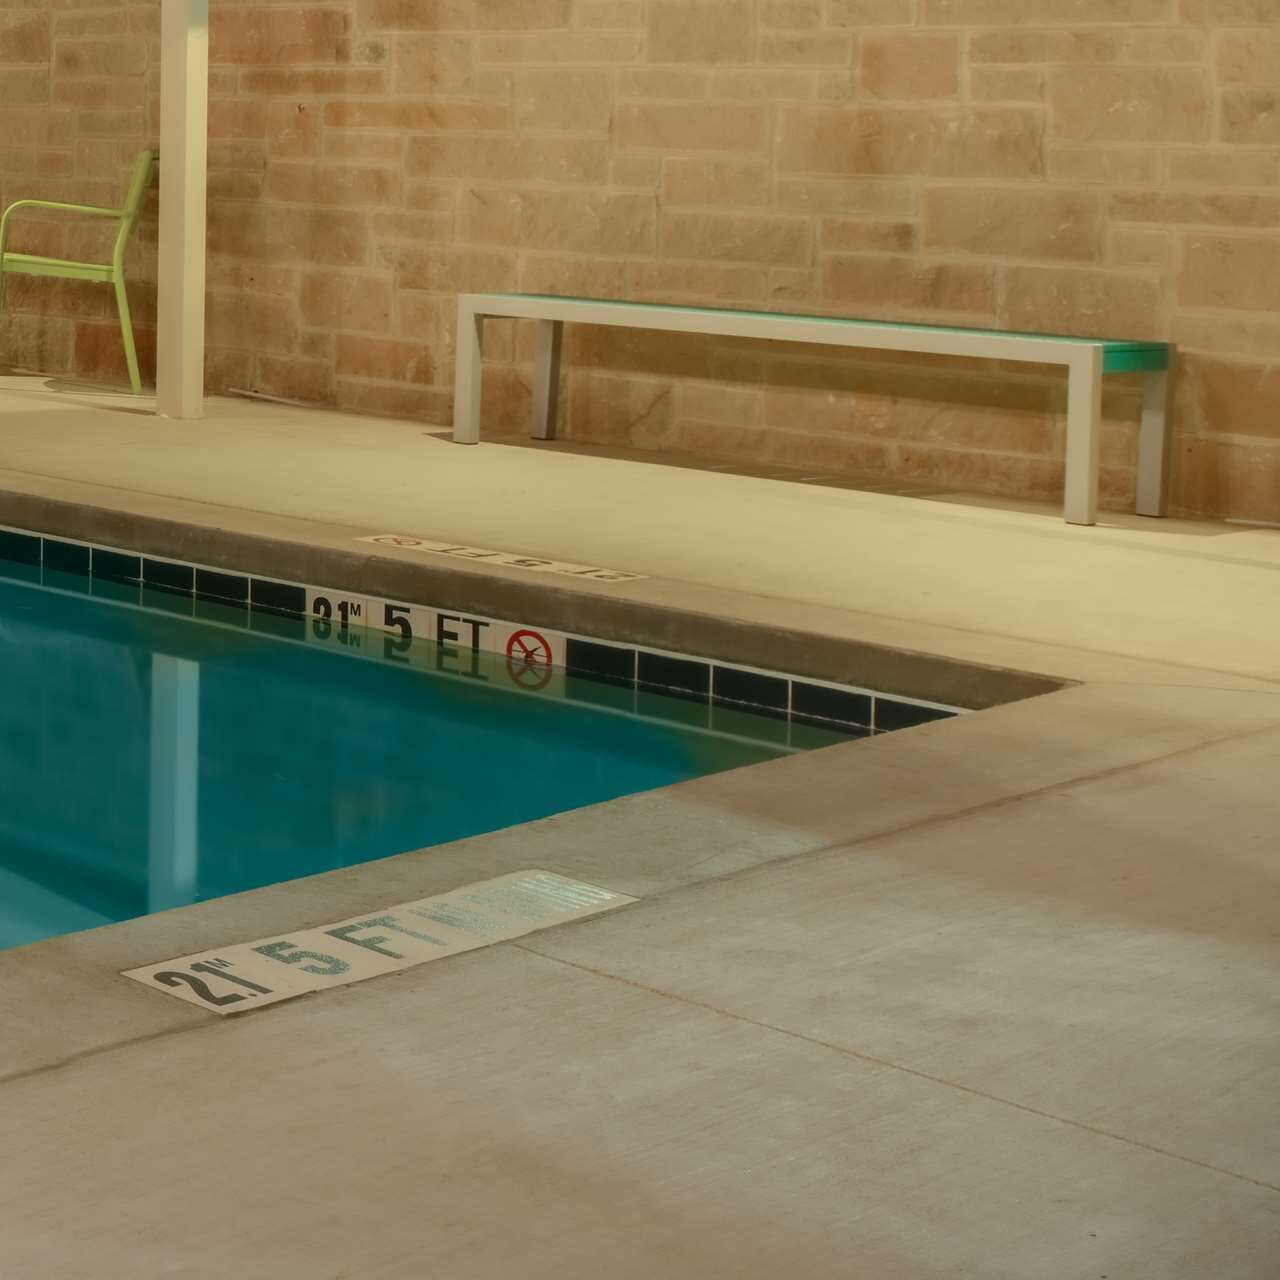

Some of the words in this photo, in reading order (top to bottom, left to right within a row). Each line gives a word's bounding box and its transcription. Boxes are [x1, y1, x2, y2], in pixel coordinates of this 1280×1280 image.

[384, 603, 413, 639] 5
[437, 612, 490, 653] FT
[250, 940, 351, 976] 5
[323, 914, 450, 961] FT
